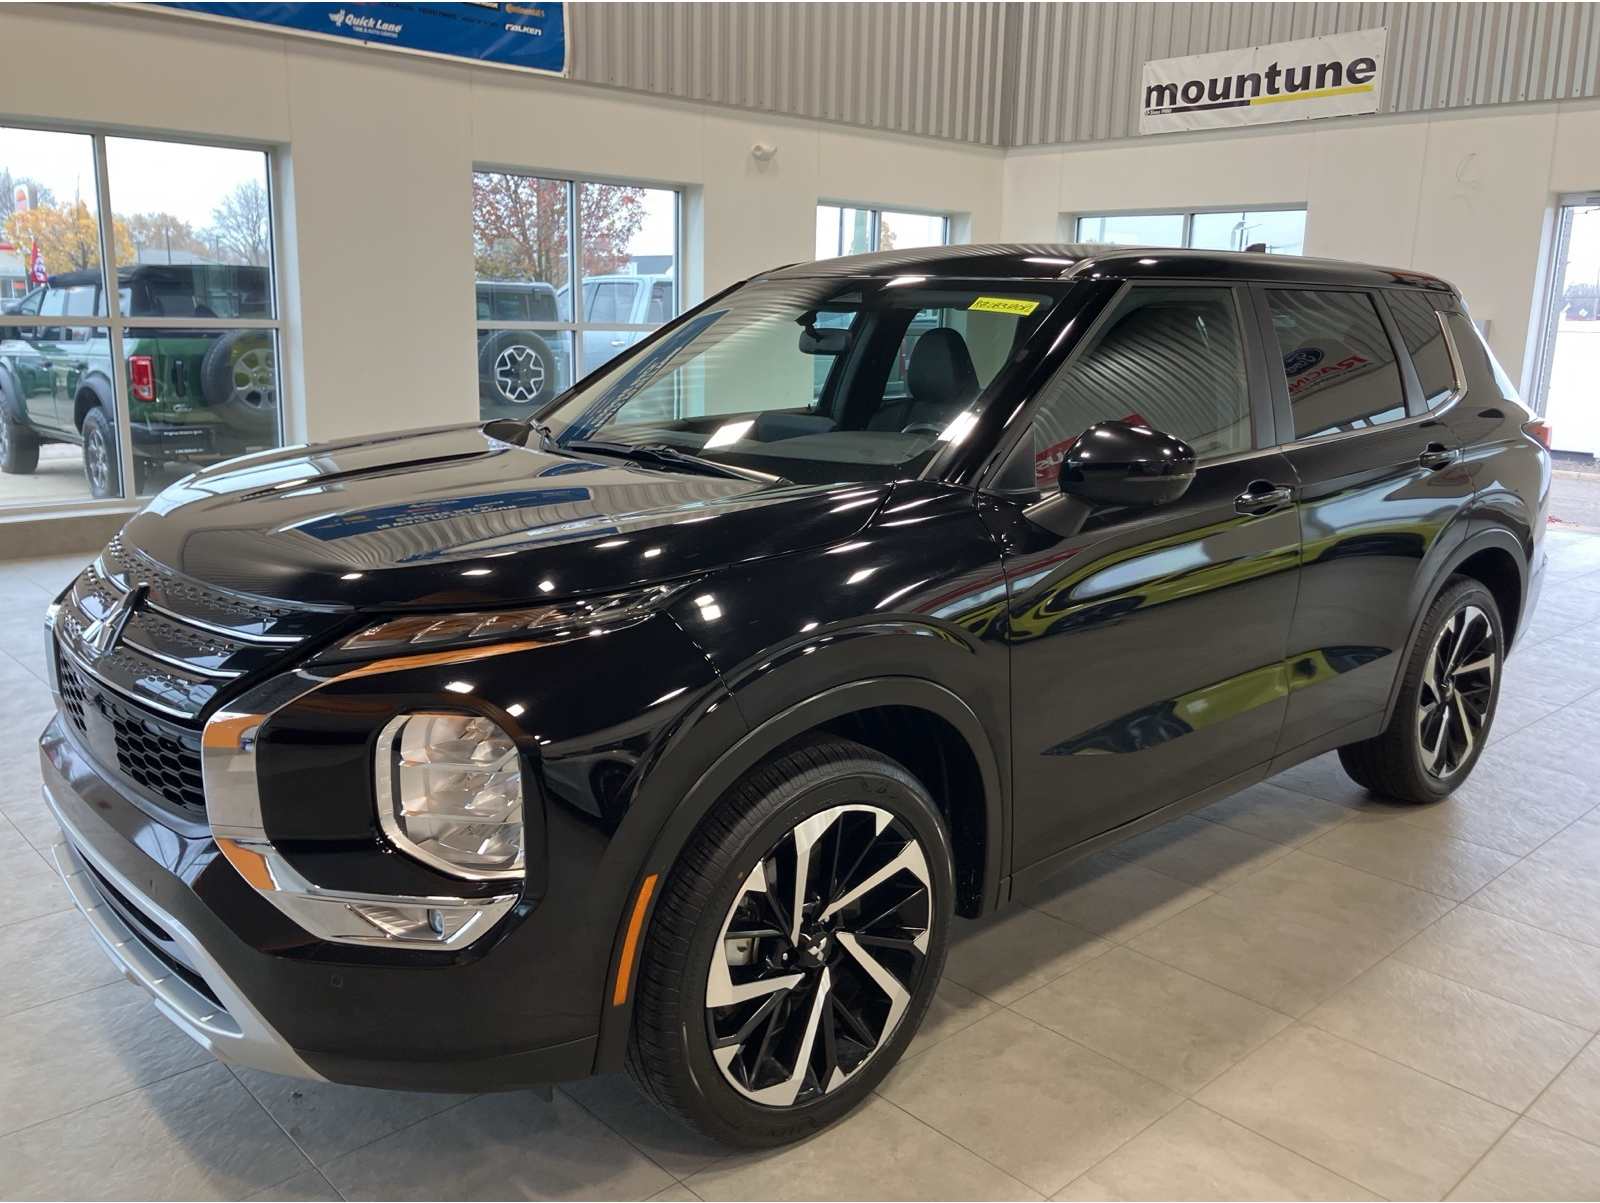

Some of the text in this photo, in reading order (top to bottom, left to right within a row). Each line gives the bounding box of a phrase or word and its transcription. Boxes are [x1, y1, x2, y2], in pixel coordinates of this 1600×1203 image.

[345, 13, 403, 33] Quick Lane
[1145, 57, 1377, 109] mountune
